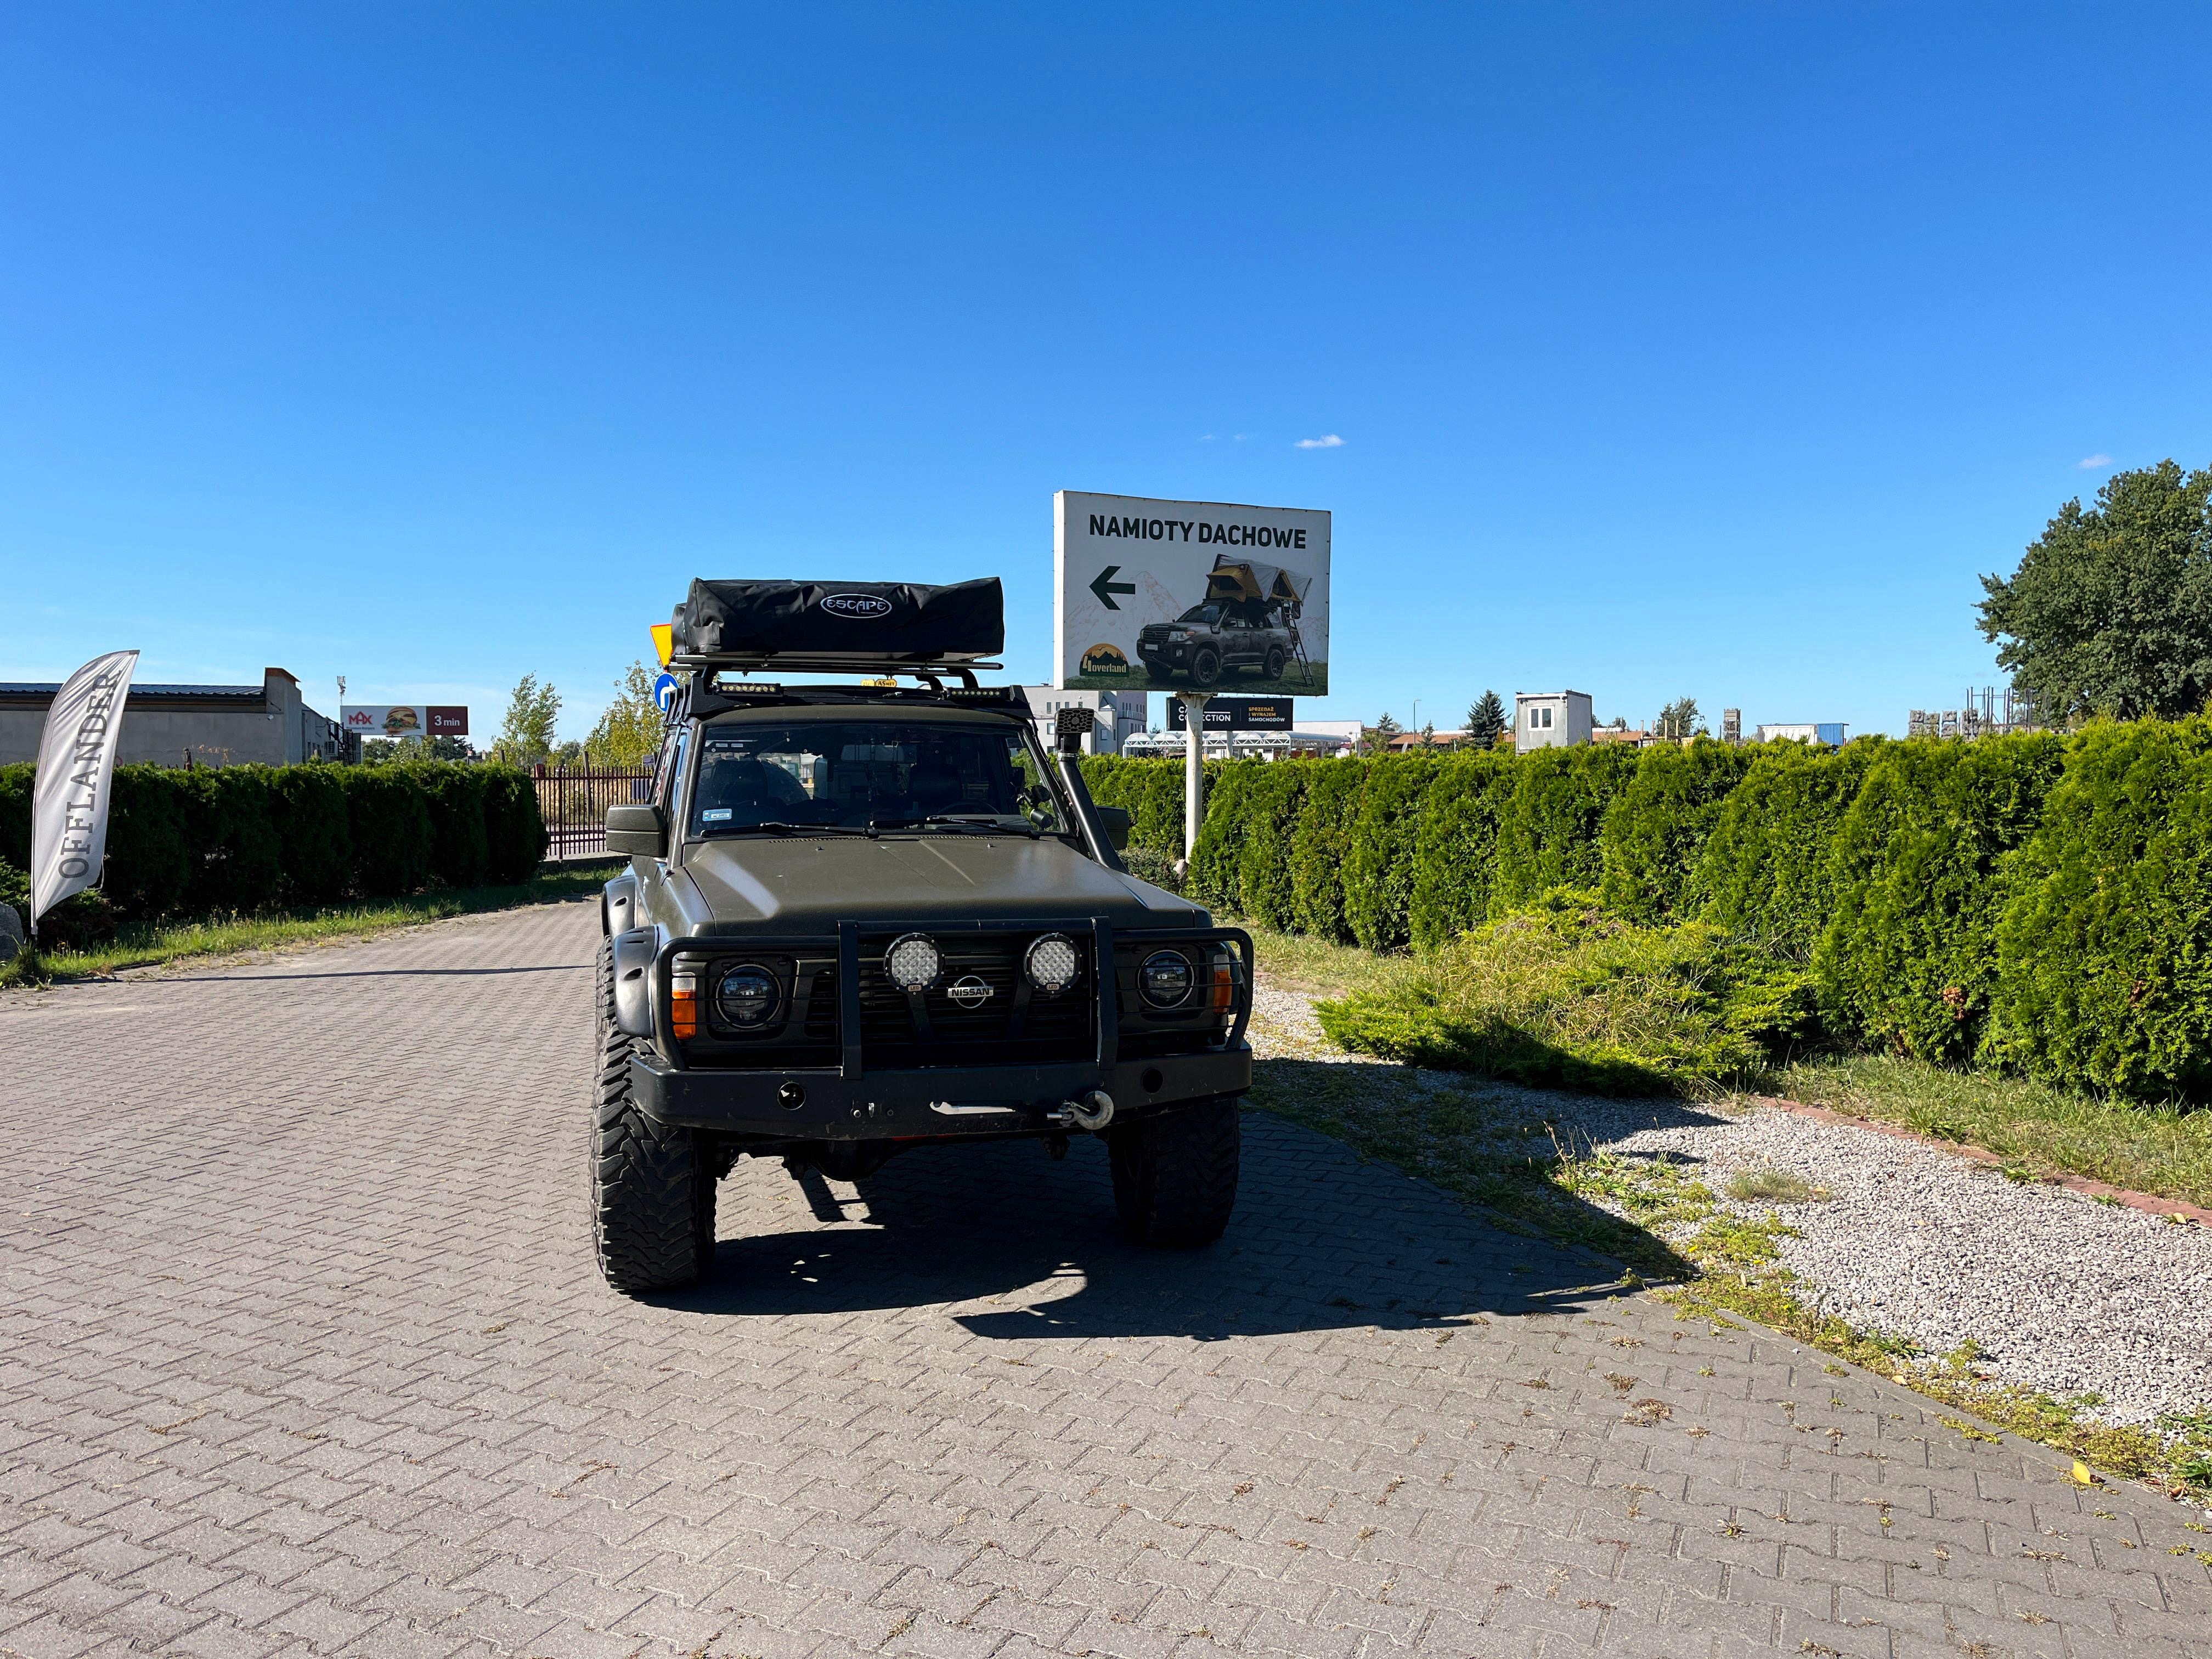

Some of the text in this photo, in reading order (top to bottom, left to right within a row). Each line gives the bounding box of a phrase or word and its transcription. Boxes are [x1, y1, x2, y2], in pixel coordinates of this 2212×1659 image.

[1090, 515, 1306, 549] NAMIOTY DACHOWE
[826, 599, 886, 614] ESCAPE
[1082, 655, 1127, 673] 4overland
[348, 711, 373, 725] MAX
[434, 715, 460, 726] 3 min
[58, 669, 123, 879] OFFLANDER
[951, 988, 990, 997] NISSAN
